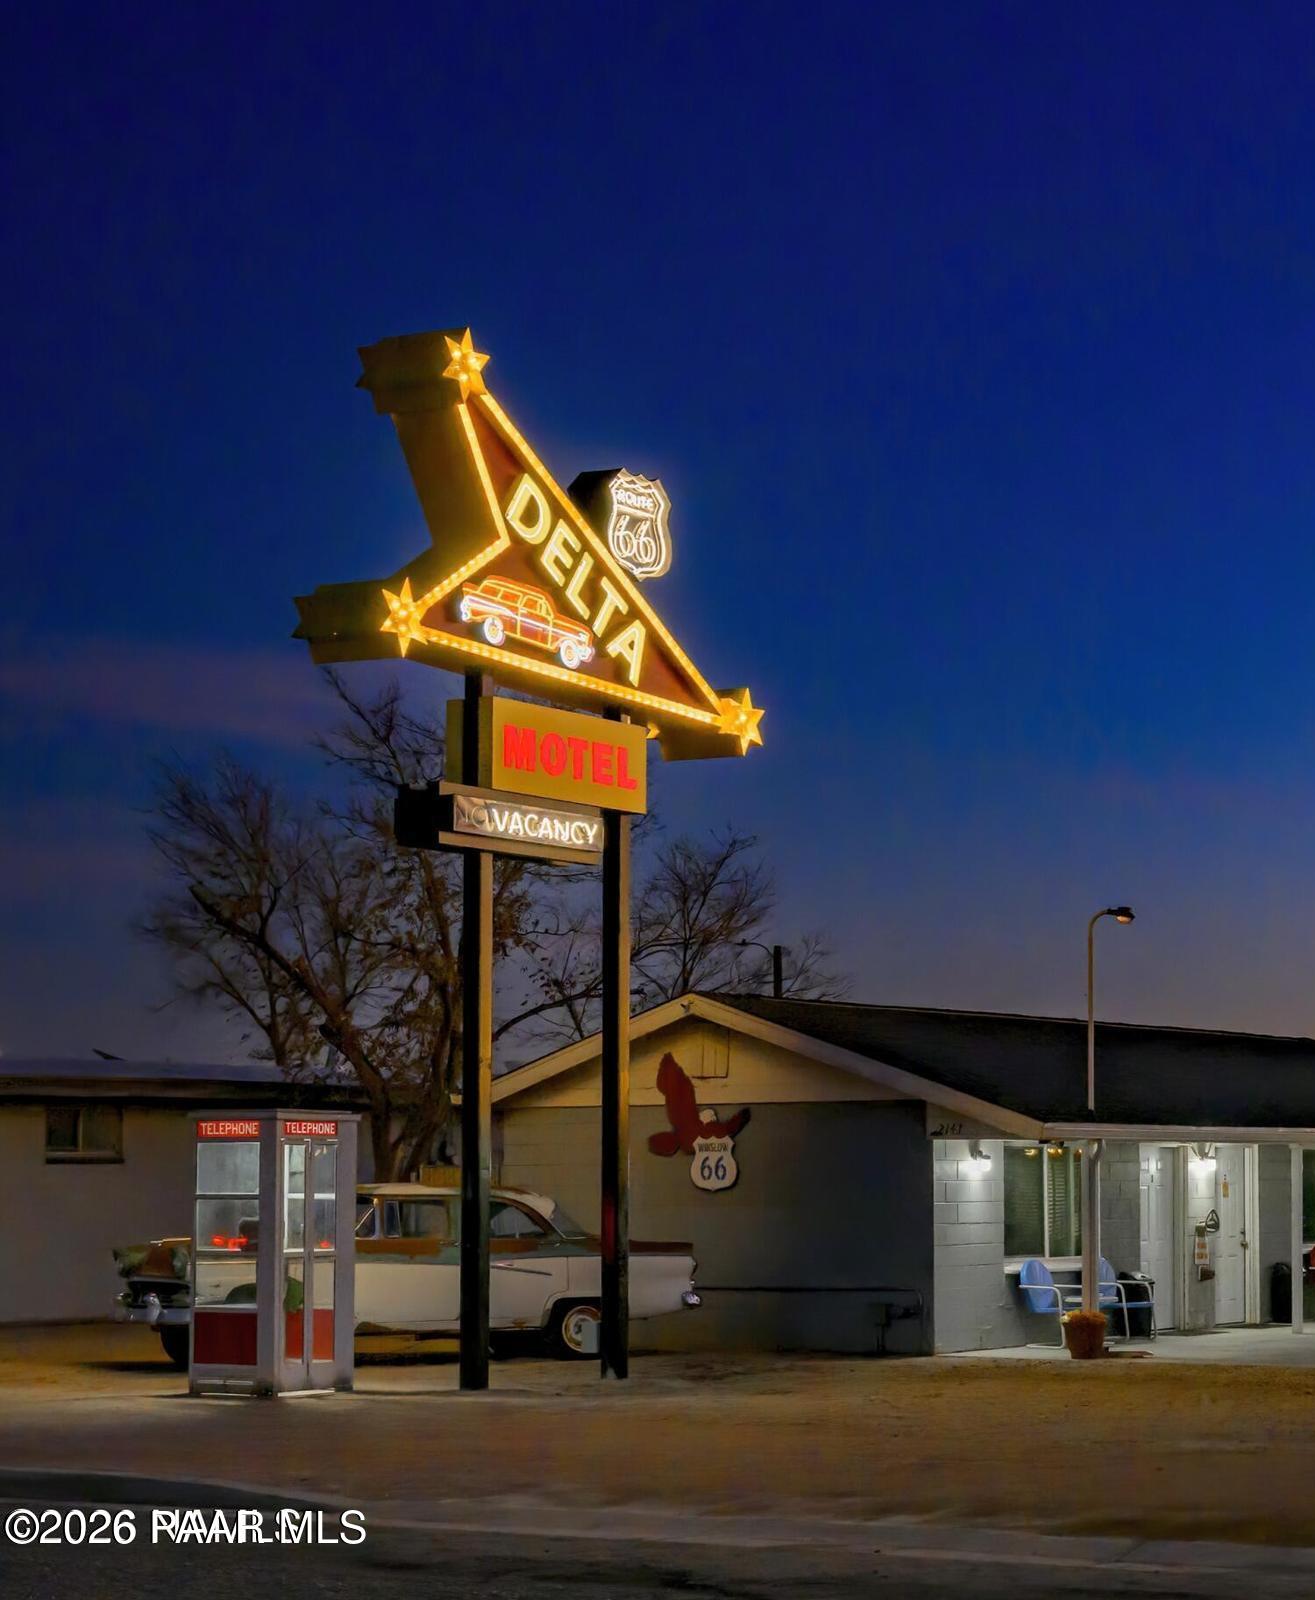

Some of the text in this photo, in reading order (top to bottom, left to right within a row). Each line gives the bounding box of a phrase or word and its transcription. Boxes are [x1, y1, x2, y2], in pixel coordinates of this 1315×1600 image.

[615, 488, 655, 511] ROUTE
[614, 514, 656, 563] 66
[505, 473, 646, 687] DELTA
[503, 724, 638, 790] MOTEL
[492, 808, 598, 844] VACANCY
[200, 1122, 259, 1135] TELEPHONE
[285, 1121, 336, 1135] TELEPHONE
[700, 1154, 727, 1181] 66
